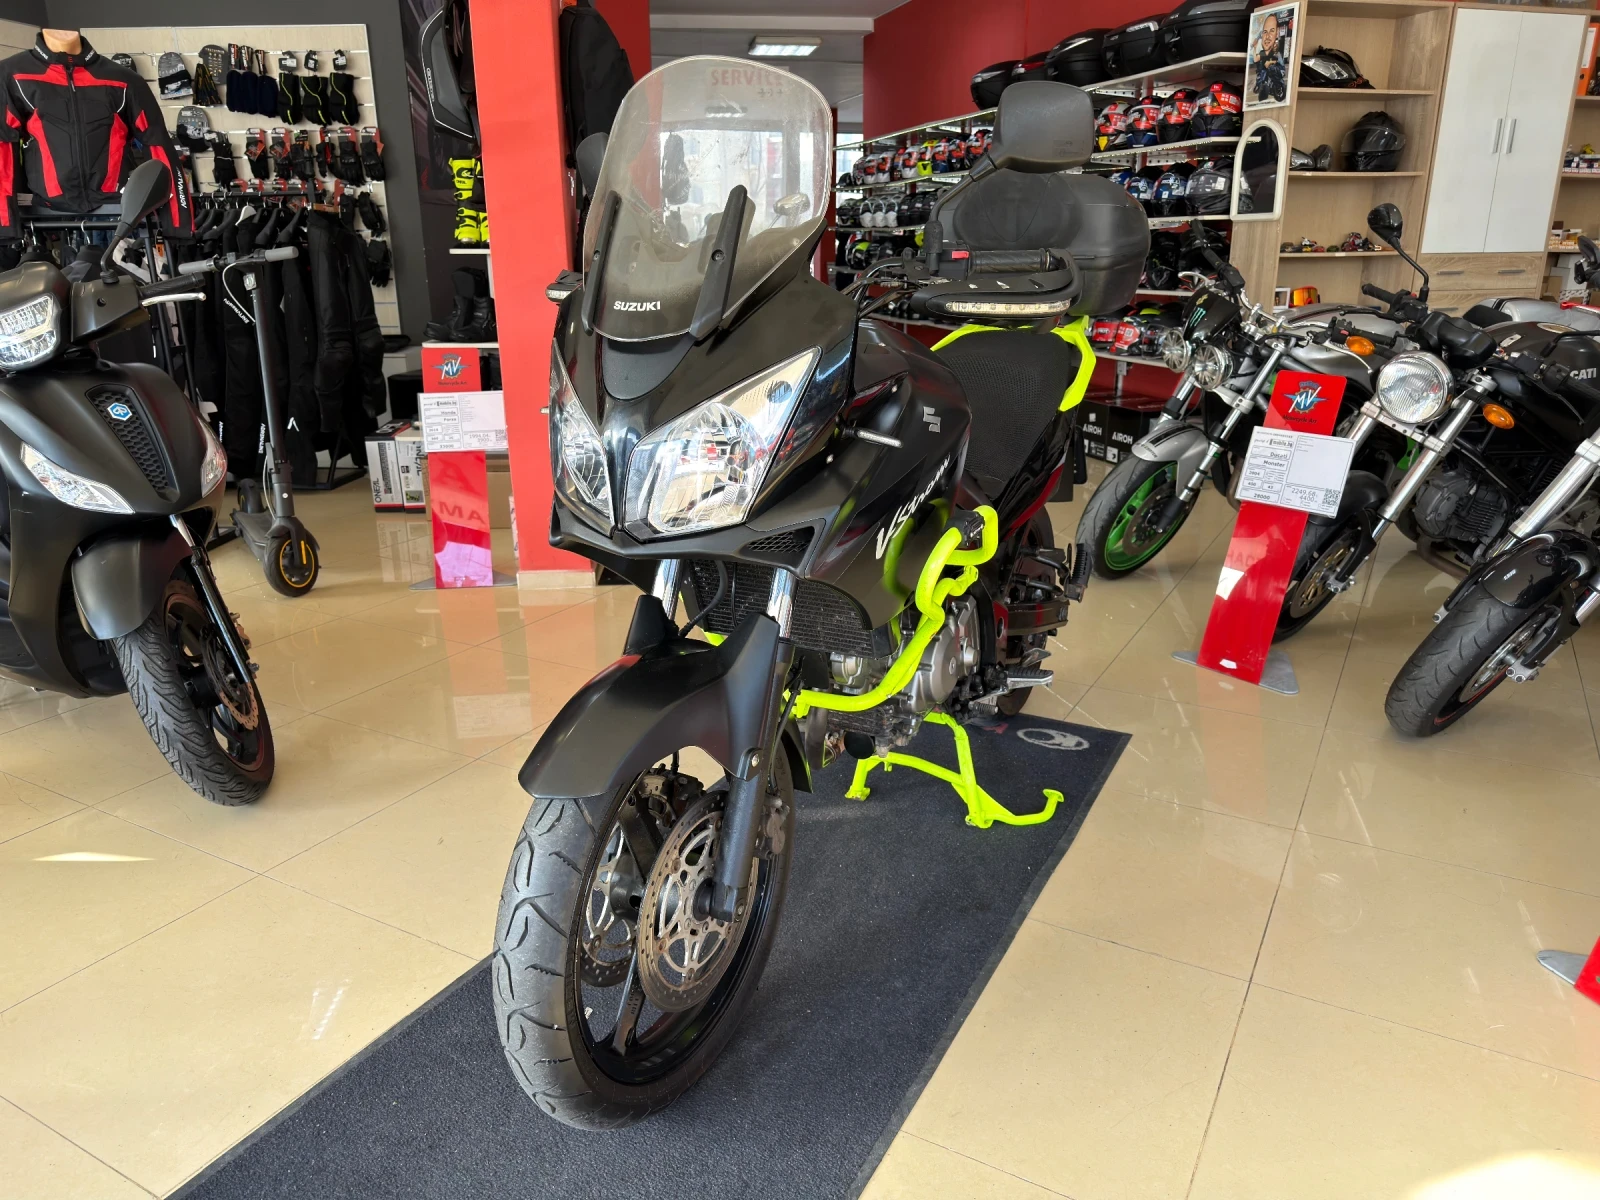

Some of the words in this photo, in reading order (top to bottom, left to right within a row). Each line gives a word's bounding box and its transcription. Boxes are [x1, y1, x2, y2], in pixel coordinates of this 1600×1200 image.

[711, 68, 784, 87] SERVICE
[613, 300, 661, 312] SUZUKI
[1569, 367, 1597, 380] CATI
[1082, 423, 1103, 436] AIROH
[1111, 431, 1134, 445] AIROH
[1269, 451, 1288, 460] Ducati
[1263, 459, 1286, 469] Monster
